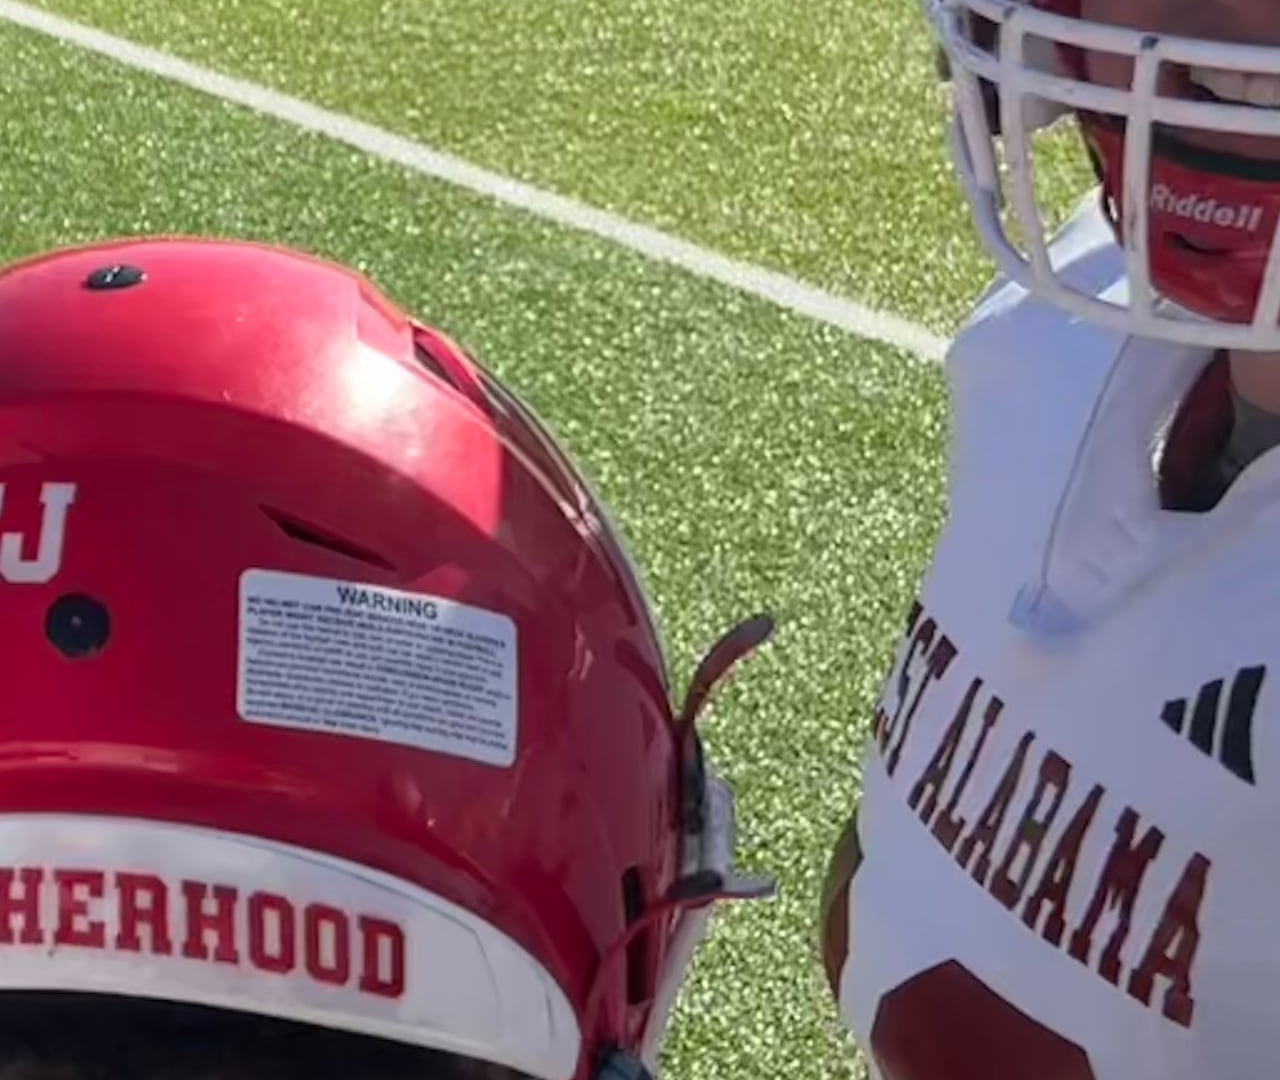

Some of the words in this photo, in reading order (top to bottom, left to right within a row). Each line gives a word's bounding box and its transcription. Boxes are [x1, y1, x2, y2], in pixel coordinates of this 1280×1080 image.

[1150, 184, 1264, 233] Riddell
[337, 586, 438, 620] WARNING
[907, 676, 1211, 1030] ALABAMA
